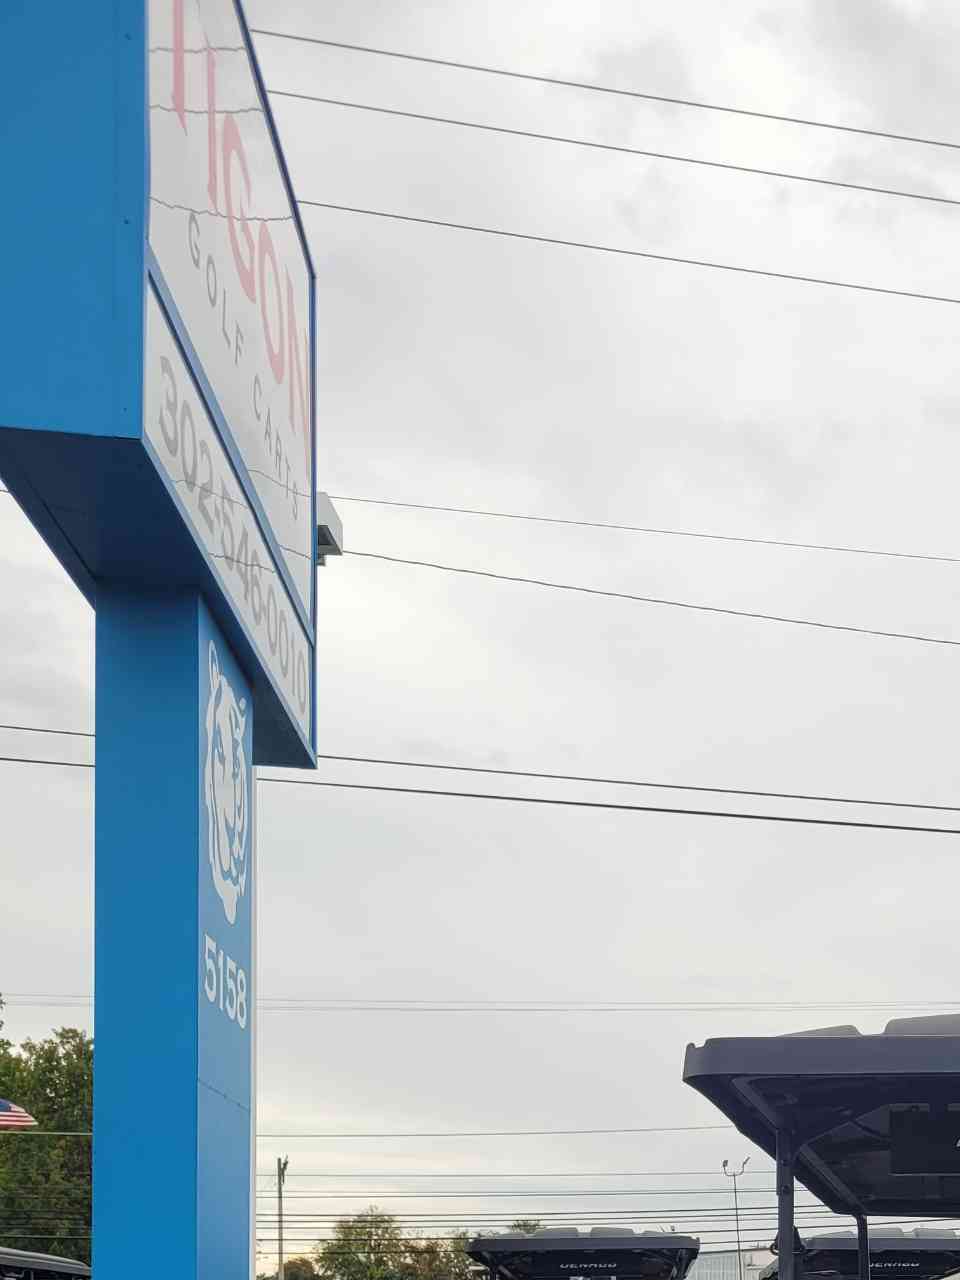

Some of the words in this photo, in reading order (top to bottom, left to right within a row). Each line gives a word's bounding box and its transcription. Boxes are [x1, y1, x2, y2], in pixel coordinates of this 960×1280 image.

[188, 212, 244, 365] GOLF
[252, 372, 299, 521] CARTS
[204, 933, 247, 1030] 5158
